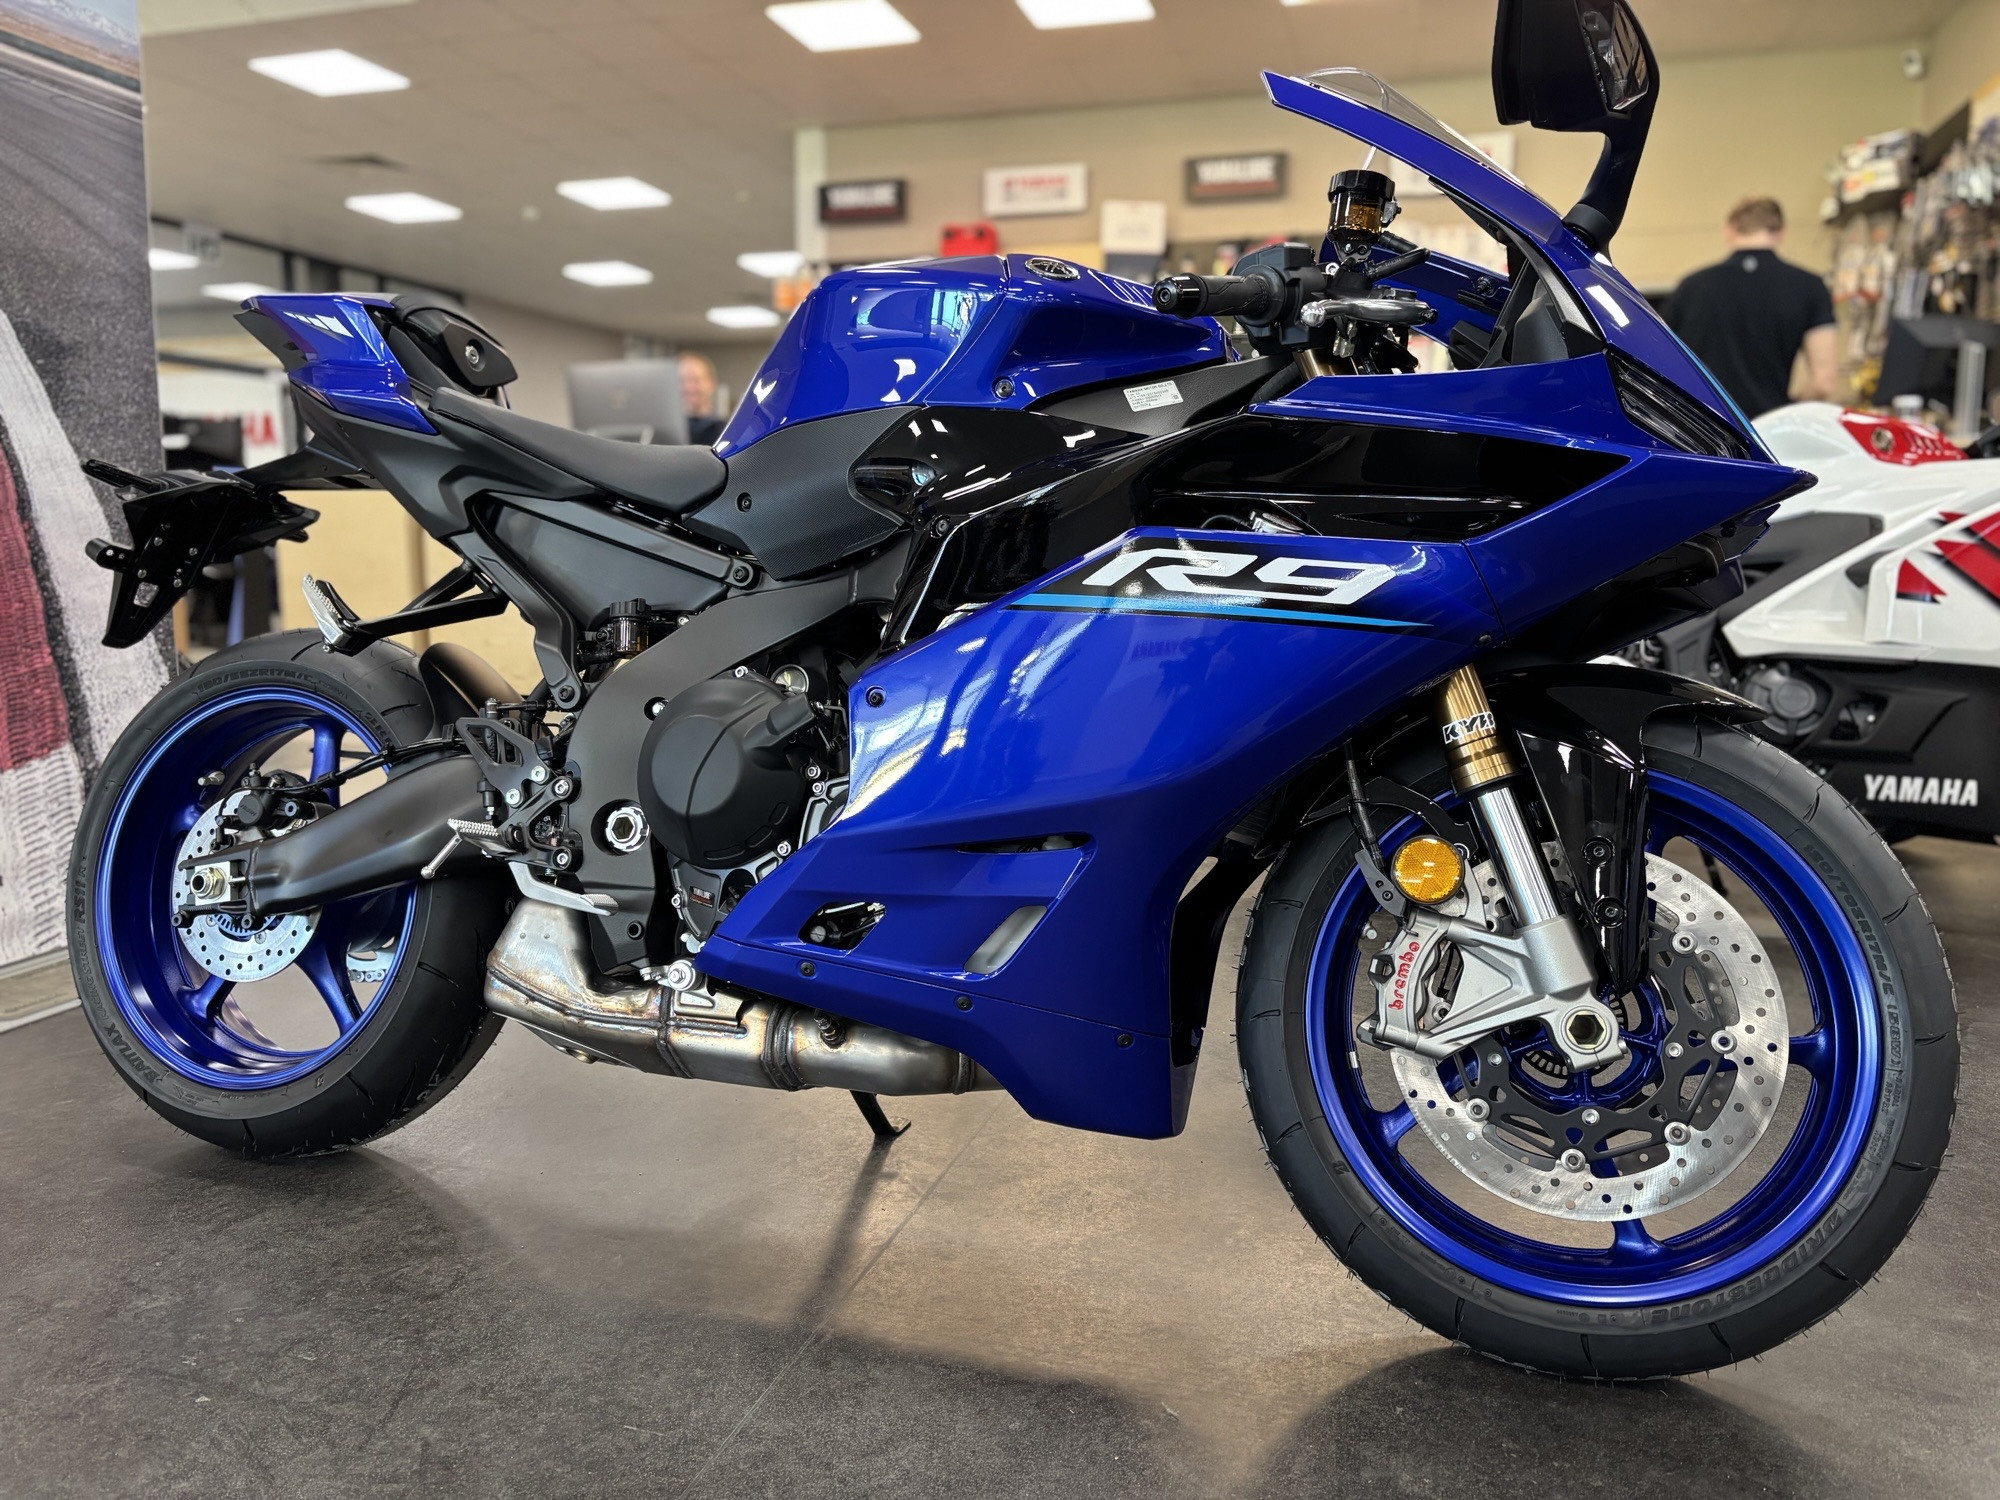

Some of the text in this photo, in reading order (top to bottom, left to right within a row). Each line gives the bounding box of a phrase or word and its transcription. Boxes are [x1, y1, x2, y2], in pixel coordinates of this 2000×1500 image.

[1082, 548, 1396, 604] R9
[1442, 711, 1496, 744] KYB
[1864, 774, 1979, 807] YAMAHA
[75, 880, 86, 924] RS11
[77, 925, 91, 974] STREET
[1388, 941, 1420, 1010] brembo
[1651, 1209, 1842, 1324] BRIDGESTONE
